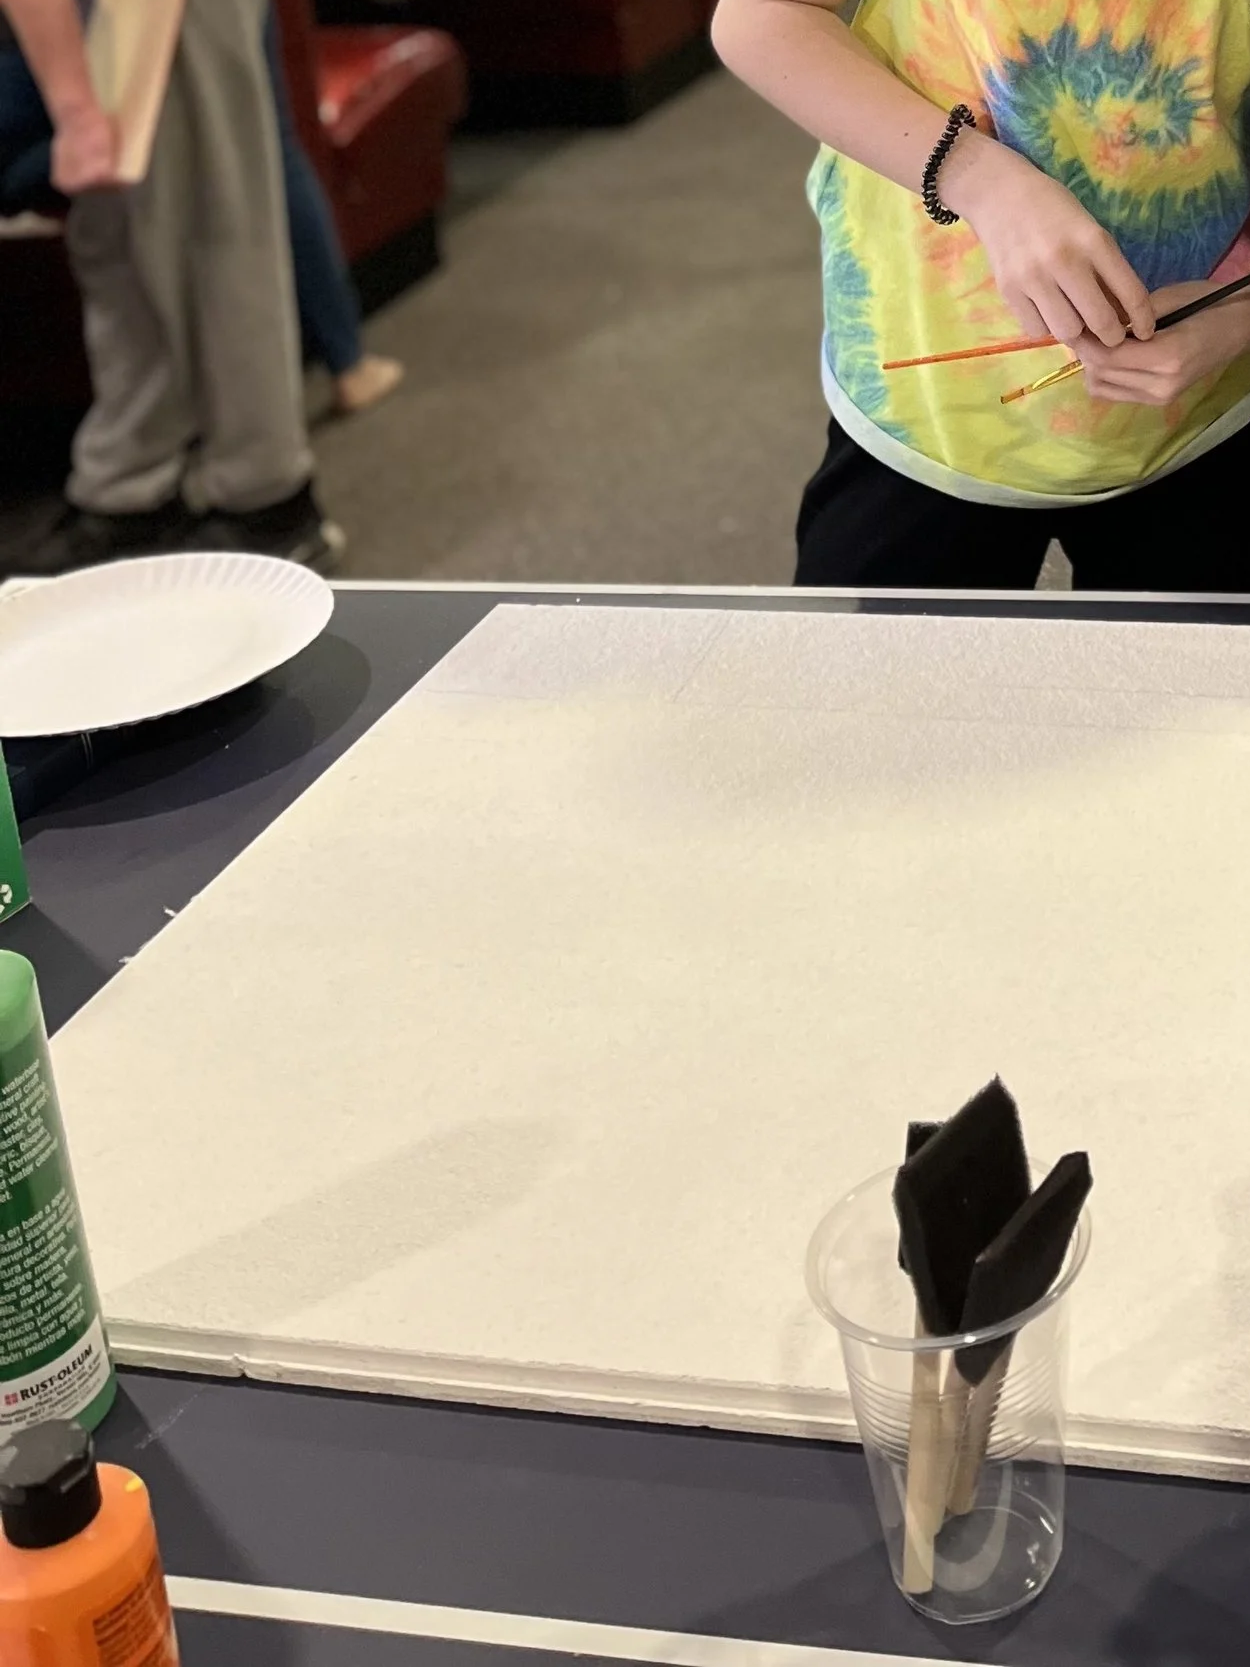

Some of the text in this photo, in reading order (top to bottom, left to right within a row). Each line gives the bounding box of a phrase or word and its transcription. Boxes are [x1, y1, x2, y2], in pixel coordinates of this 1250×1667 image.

[8, 1163, 34, 1185] water
[7, 1226, 20, 1238] en
[21, 1210, 44, 1230] base
[34, 1235, 46, 1248] en
[3, 1271, 32, 1291] sobre
[20, 1284, 32, 1296] de
[35, 1303, 42, 1315] y
[7, 1331, 40, 1352] limpia
[41, 1319, 58, 1336] con
[25, 1326, 67, 1357] mientras
